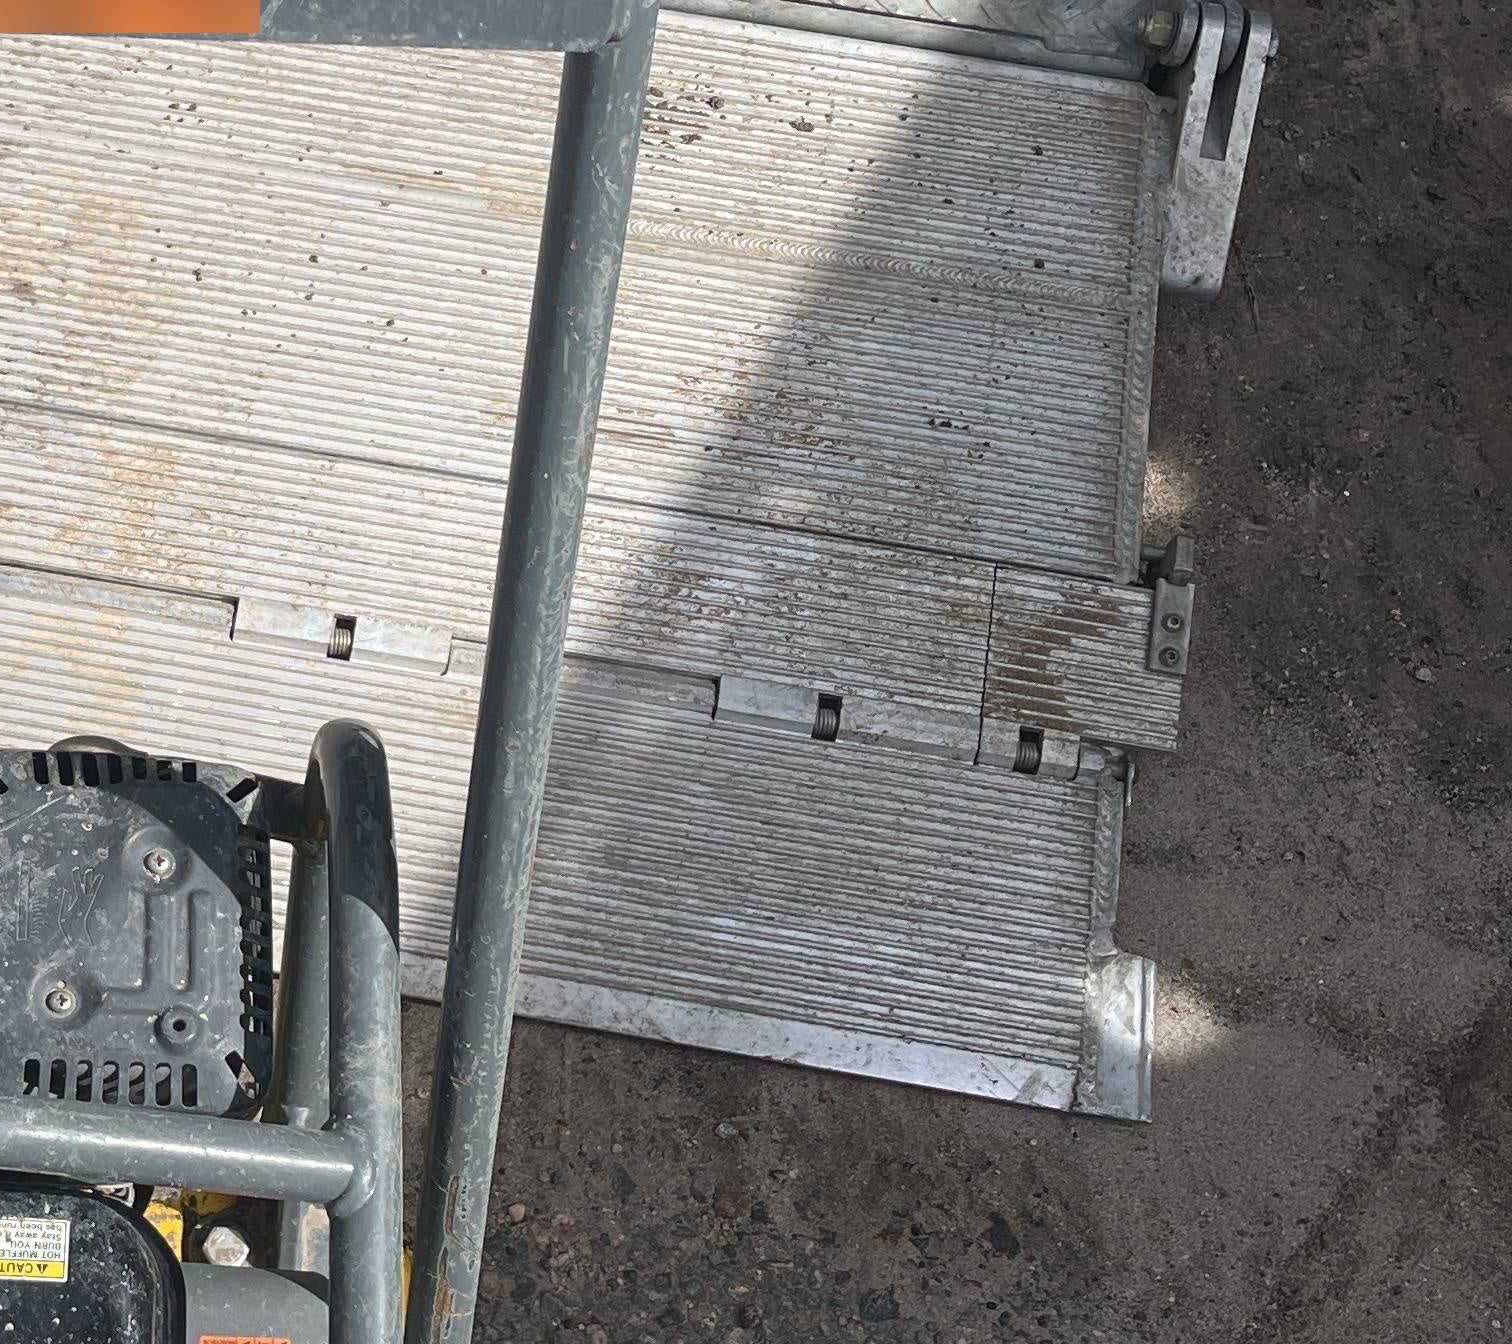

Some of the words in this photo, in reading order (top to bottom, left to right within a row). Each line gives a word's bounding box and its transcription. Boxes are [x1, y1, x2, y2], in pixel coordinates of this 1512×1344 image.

[19, 1221, 44, 1232] been
[45, 1224, 62, 1233] has
[14, 1230, 39, 1239] away
[40, 1232, 62, 1242] Stay
[34, 1241, 61, 1251] BURN
[41, 1252, 62, 1260] HOT
